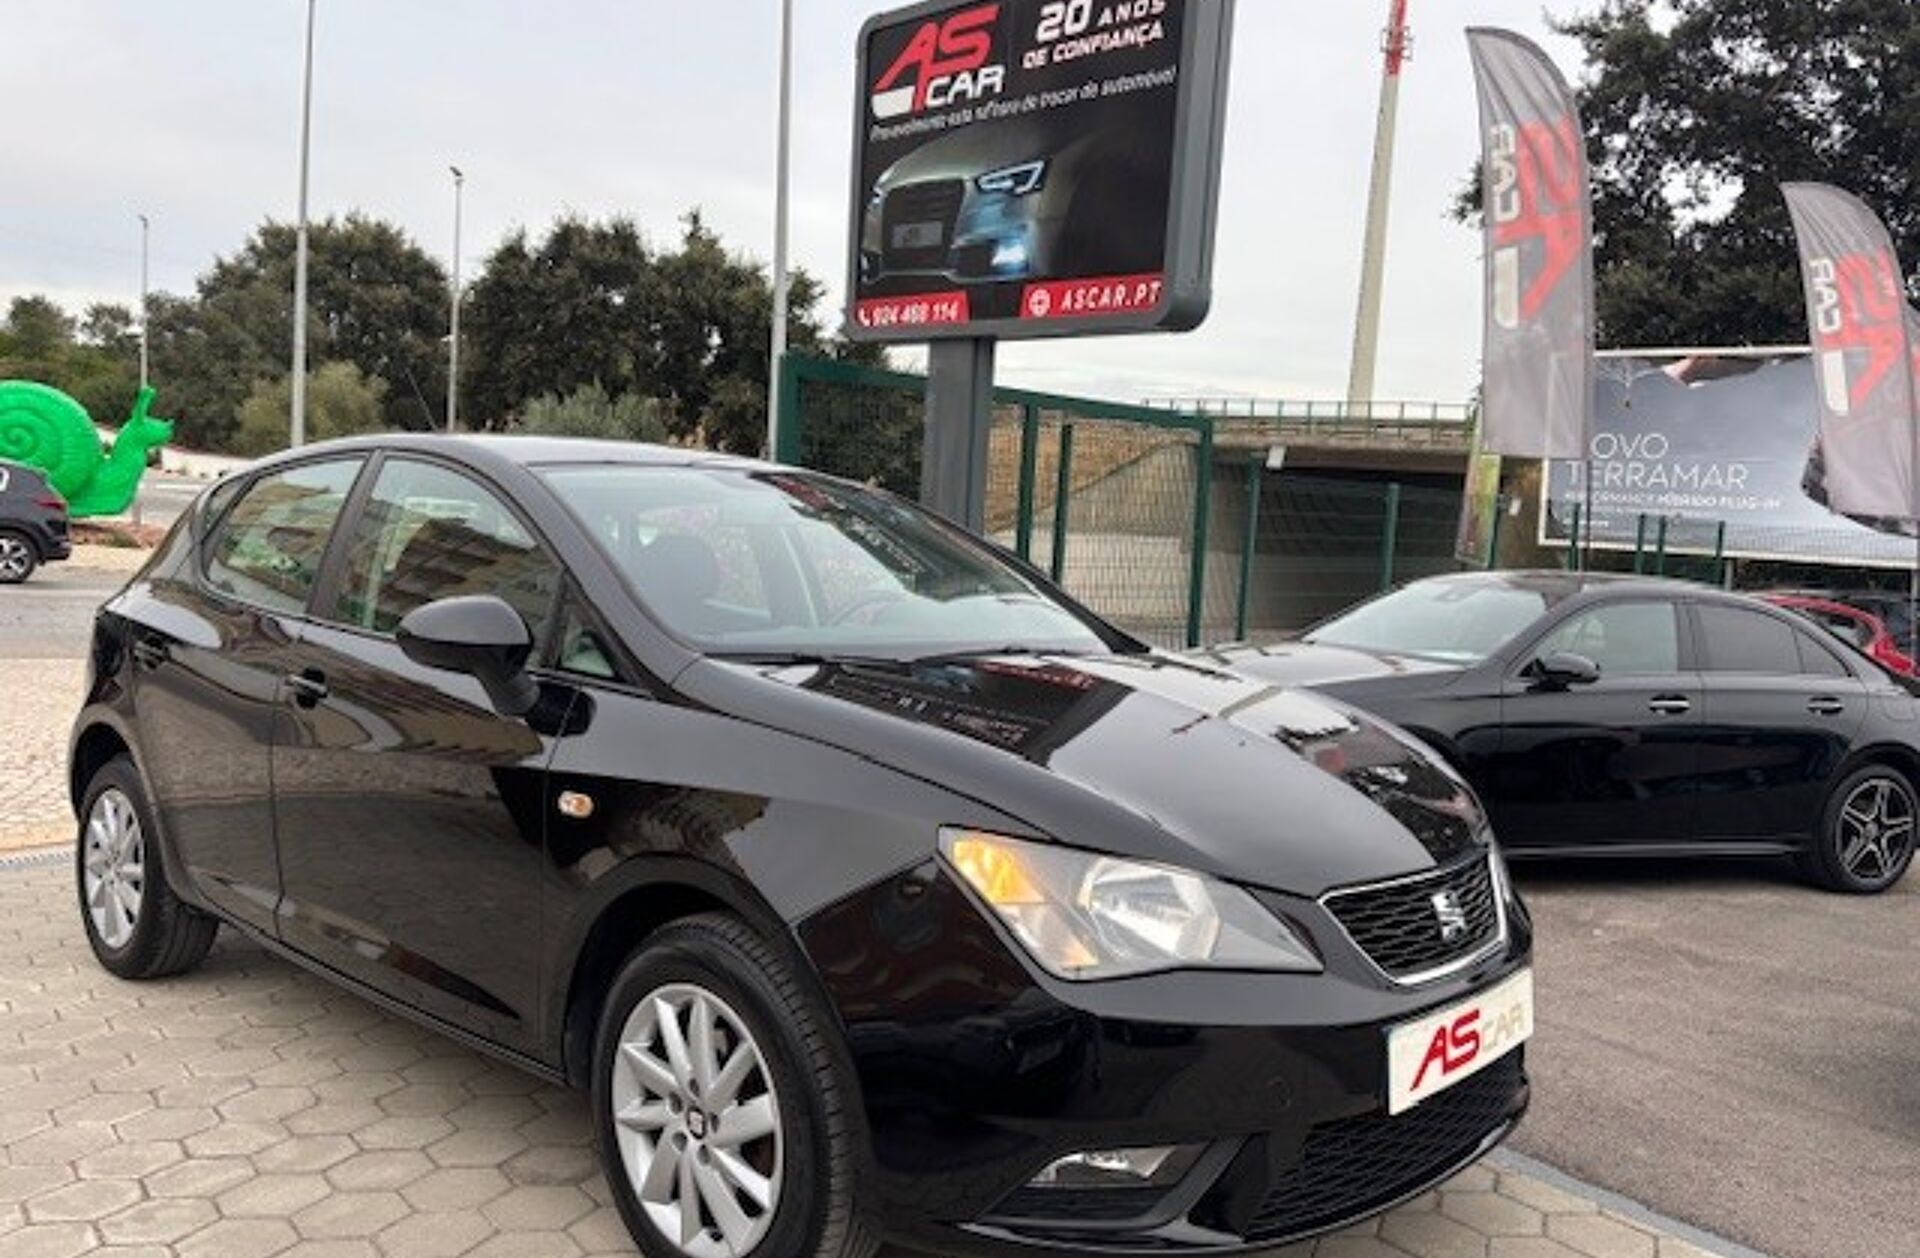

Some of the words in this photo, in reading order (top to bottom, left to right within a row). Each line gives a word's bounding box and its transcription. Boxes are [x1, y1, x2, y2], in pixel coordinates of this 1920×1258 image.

[1036, 0, 1093, 42] 20
[1098, 0, 1166, 26] ANOS
[873, 4, 1001, 113] AS
[1023, 47, 1048, 69] DE
[1052, 20, 1164, 64] CONFIANÇA
[926, 64, 1005, 108] CAR
[1060, 281, 1162, 312] ASCAR.PT
[1590, 432, 1670, 460] OVO
[1409, 1007, 1480, 1092] AS
